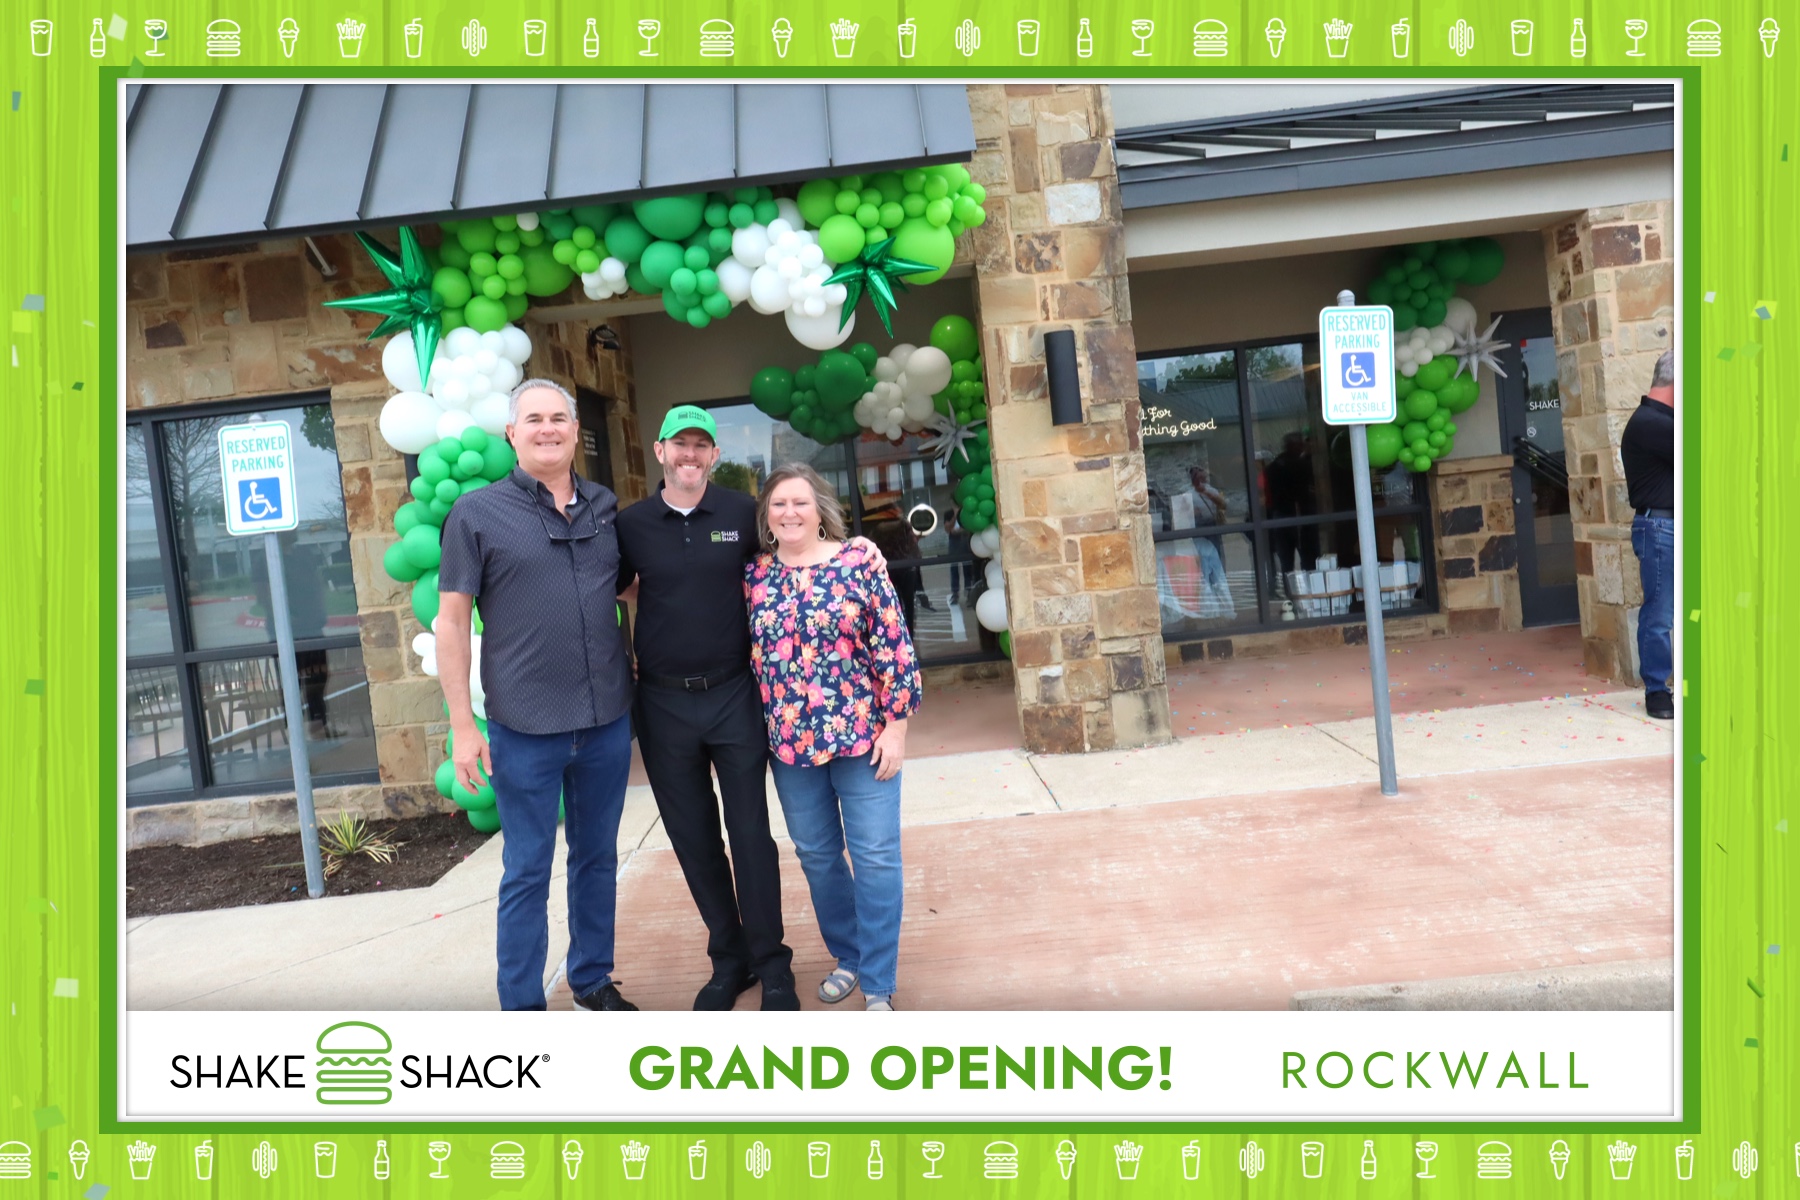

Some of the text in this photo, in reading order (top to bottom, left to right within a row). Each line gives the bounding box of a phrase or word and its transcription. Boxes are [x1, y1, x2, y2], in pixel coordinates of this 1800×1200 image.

[1327, 314, 1386, 332] RESERVED
[1335, 334, 1380, 349] PARKING
[1351, 391, 1369, 400] VAN
[1333, 402, 1386, 413] ACCESSIBLE
[1529, 399, 1560, 411] SHAKE
[1147, 406, 1172, 422] For
[1141, 417, 1217, 437] thing Good
[226, 436, 286, 455] RESERVED
[232, 455, 284, 473] PARKING
